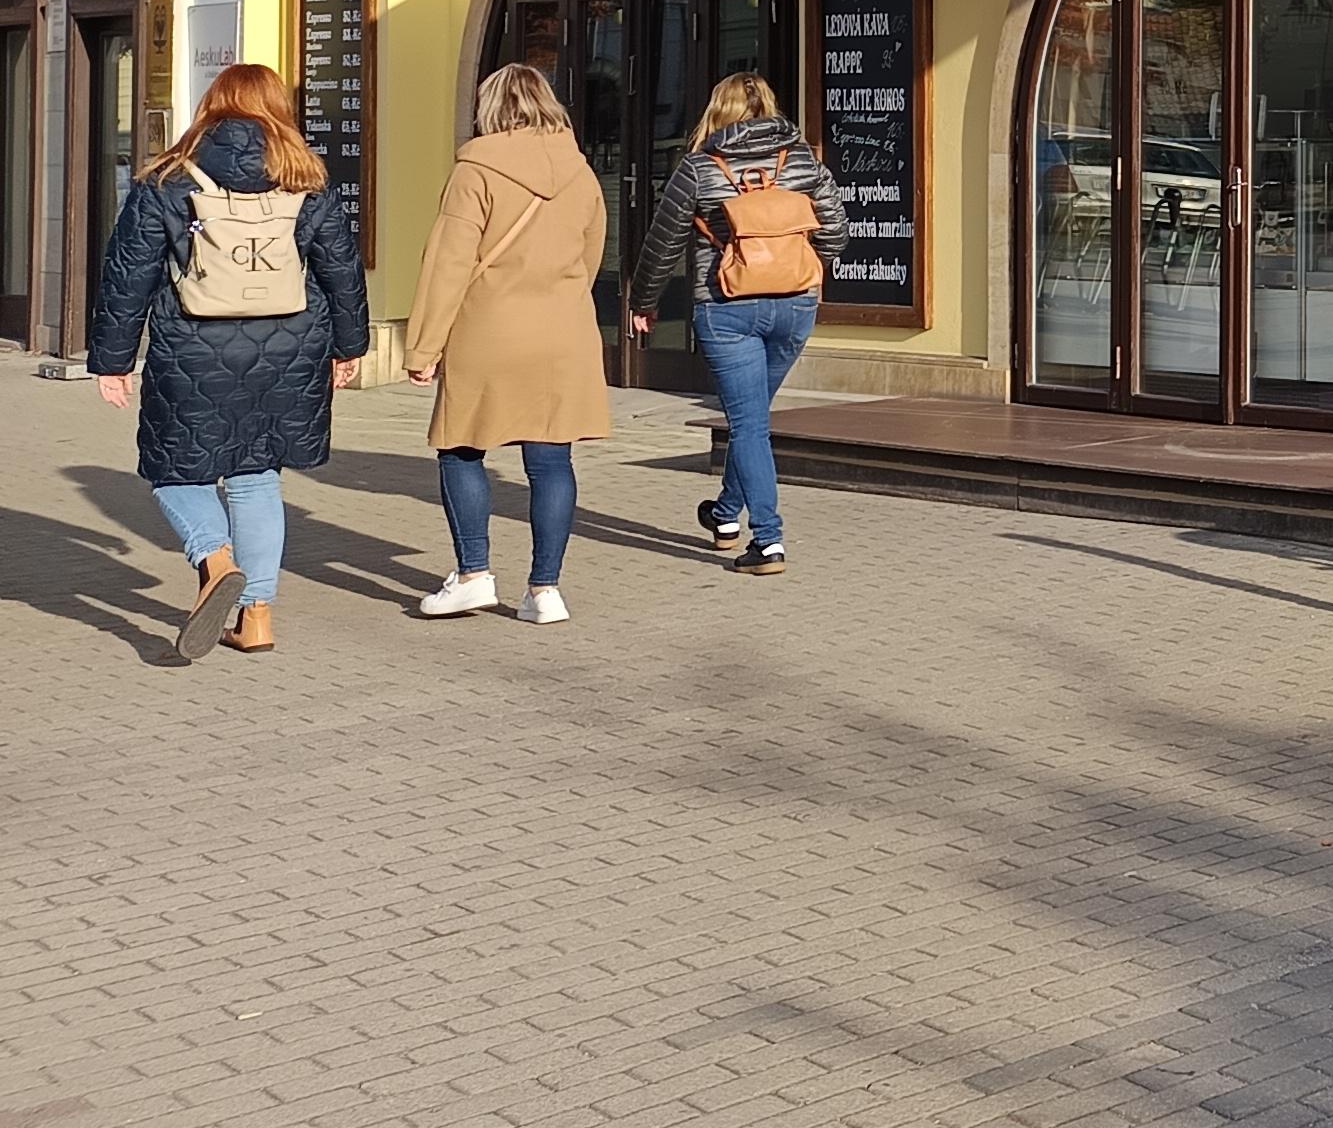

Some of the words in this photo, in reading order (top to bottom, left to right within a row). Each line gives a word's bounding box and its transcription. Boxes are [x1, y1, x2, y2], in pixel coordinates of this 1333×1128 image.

[825, 7, 862, 37] LEDOVÁ
[863, 7, 890, 36] KÁVA
[194, 45, 234, 67] AeskuLab
[825, 50, 863, 75] FRAPPE
[826, 88, 841, 111] ICE
[842, 88, 872, 111] LATTE
[873, 87, 905, 112] KOKOS
[858, 178, 901, 207] vyrobená
[847, 216, 877, 238] erstvá
[868, 256, 907, 286] zákusky
